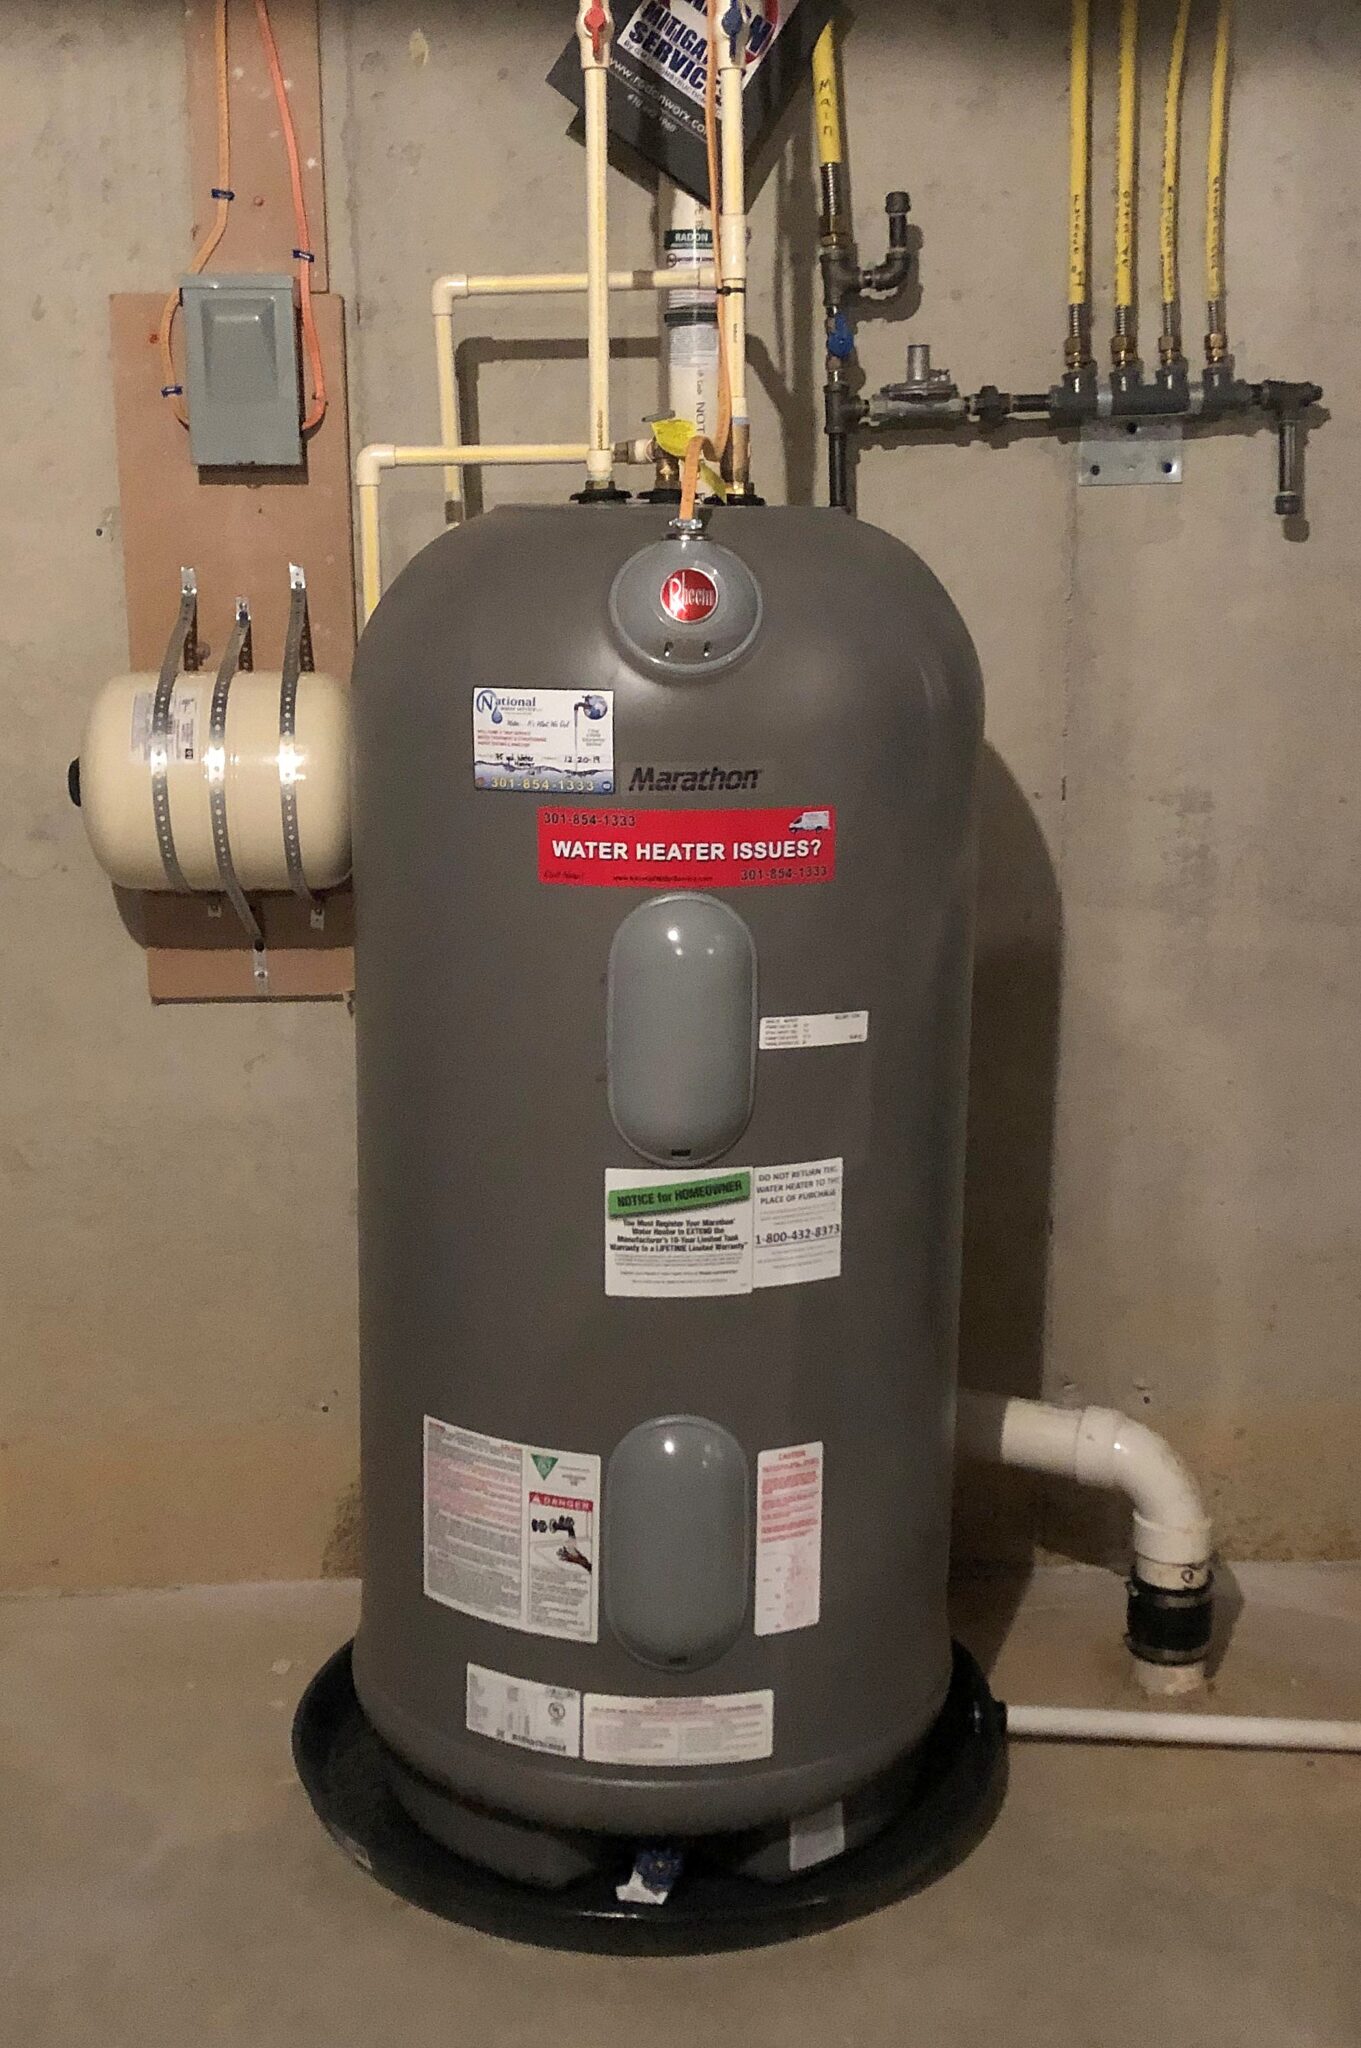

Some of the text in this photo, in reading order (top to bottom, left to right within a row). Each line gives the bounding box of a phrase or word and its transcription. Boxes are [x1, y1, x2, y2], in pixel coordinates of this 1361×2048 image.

[628, 20, 720, 106] SERVIC
[675, 232, 708, 242] RADON
[696, 401, 706, 434] NOT
[669, 571, 714, 616] Rheem
[481, 695, 536, 711] National
[491, 777, 594, 791] 301-854-1333
[628, 766, 759, 791] Marathon
[544, 812, 636, 827] 301-854-1333
[552, 839, 822, 861] WATER HEATER ISSUES?
[741, 866, 827, 881] 301-854-1333
[758, 1173, 771, 1182] DO
[773, 1172, 790, 1180] NOT
[791, 1168, 821, 1178] RETURN
[617, 1180, 743, 1207] NOTICE for HOMEOWNER
[756, 1184, 784, 1194] WATER
[786, 1180, 814, 1190] HEATER
[760, 1196, 784, 1205] PLACE
[786, 1194, 797, 1202] OF
[655, 1219, 684, 1227] Register
[686, 1227, 712, 1235] EXTEND
[756, 1223, 840, 1245] 1-800-432-8373
[610, 1243, 640, 1252] Warranty
[655, 1243, 687, 1252] LIFETIME
